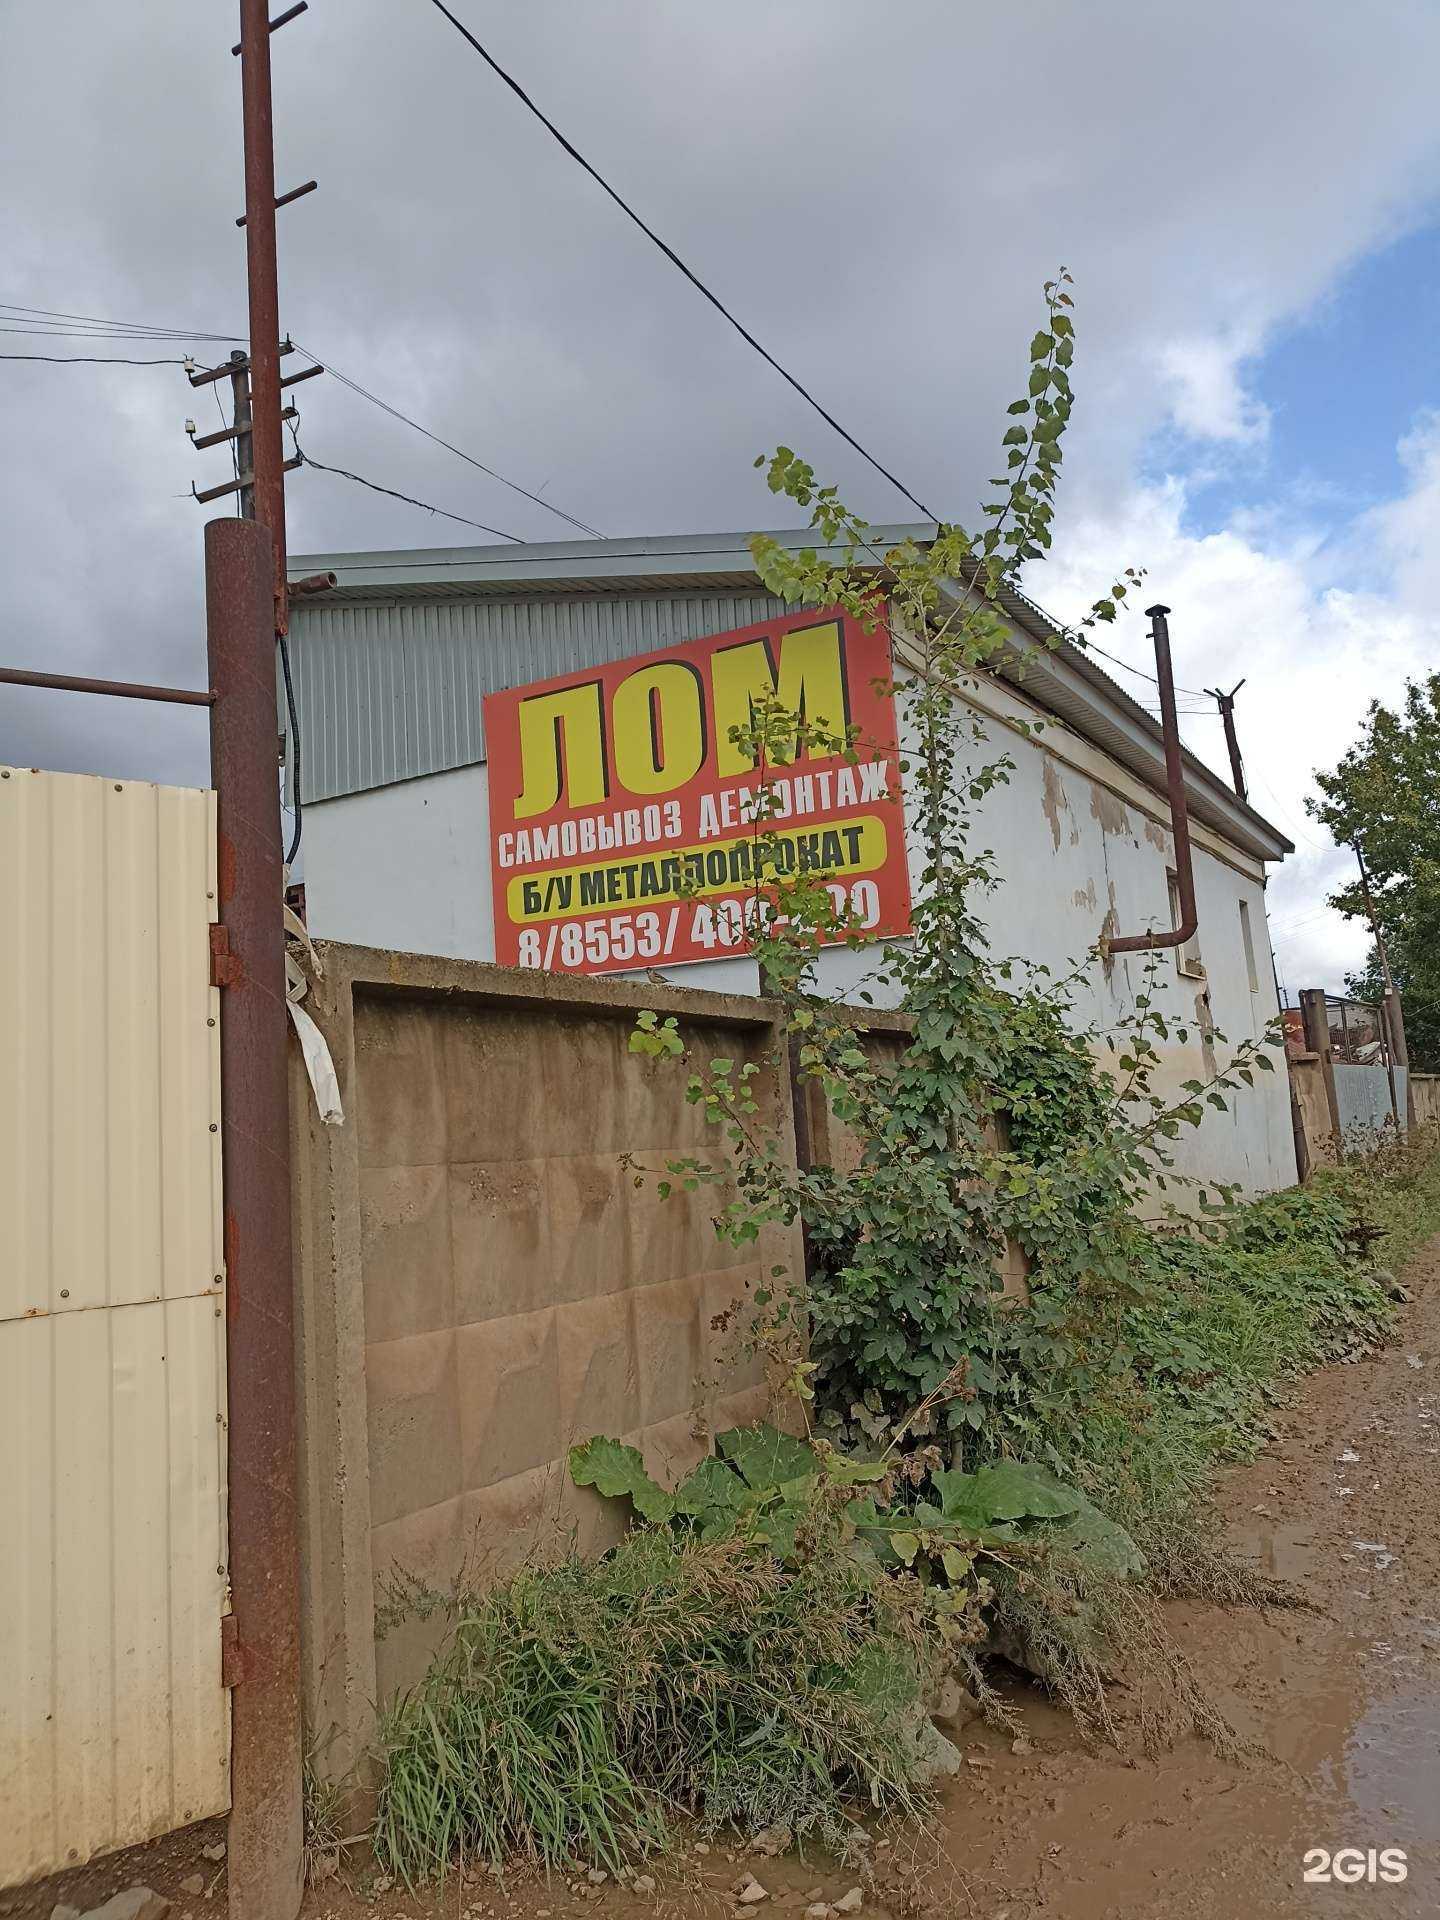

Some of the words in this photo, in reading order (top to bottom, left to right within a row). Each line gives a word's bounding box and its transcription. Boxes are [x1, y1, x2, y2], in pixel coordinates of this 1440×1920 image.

[514, 617, 852, 819] ЛОМ
[499, 800, 682, 868] САМОВЫВОЗ
[699, 760, 889, 838] ДЕМОНТАЖ
[523, 875, 572, 914] Б/У
[579, 826, 863, 906] МЕТАЛЛОПРОКАТ
